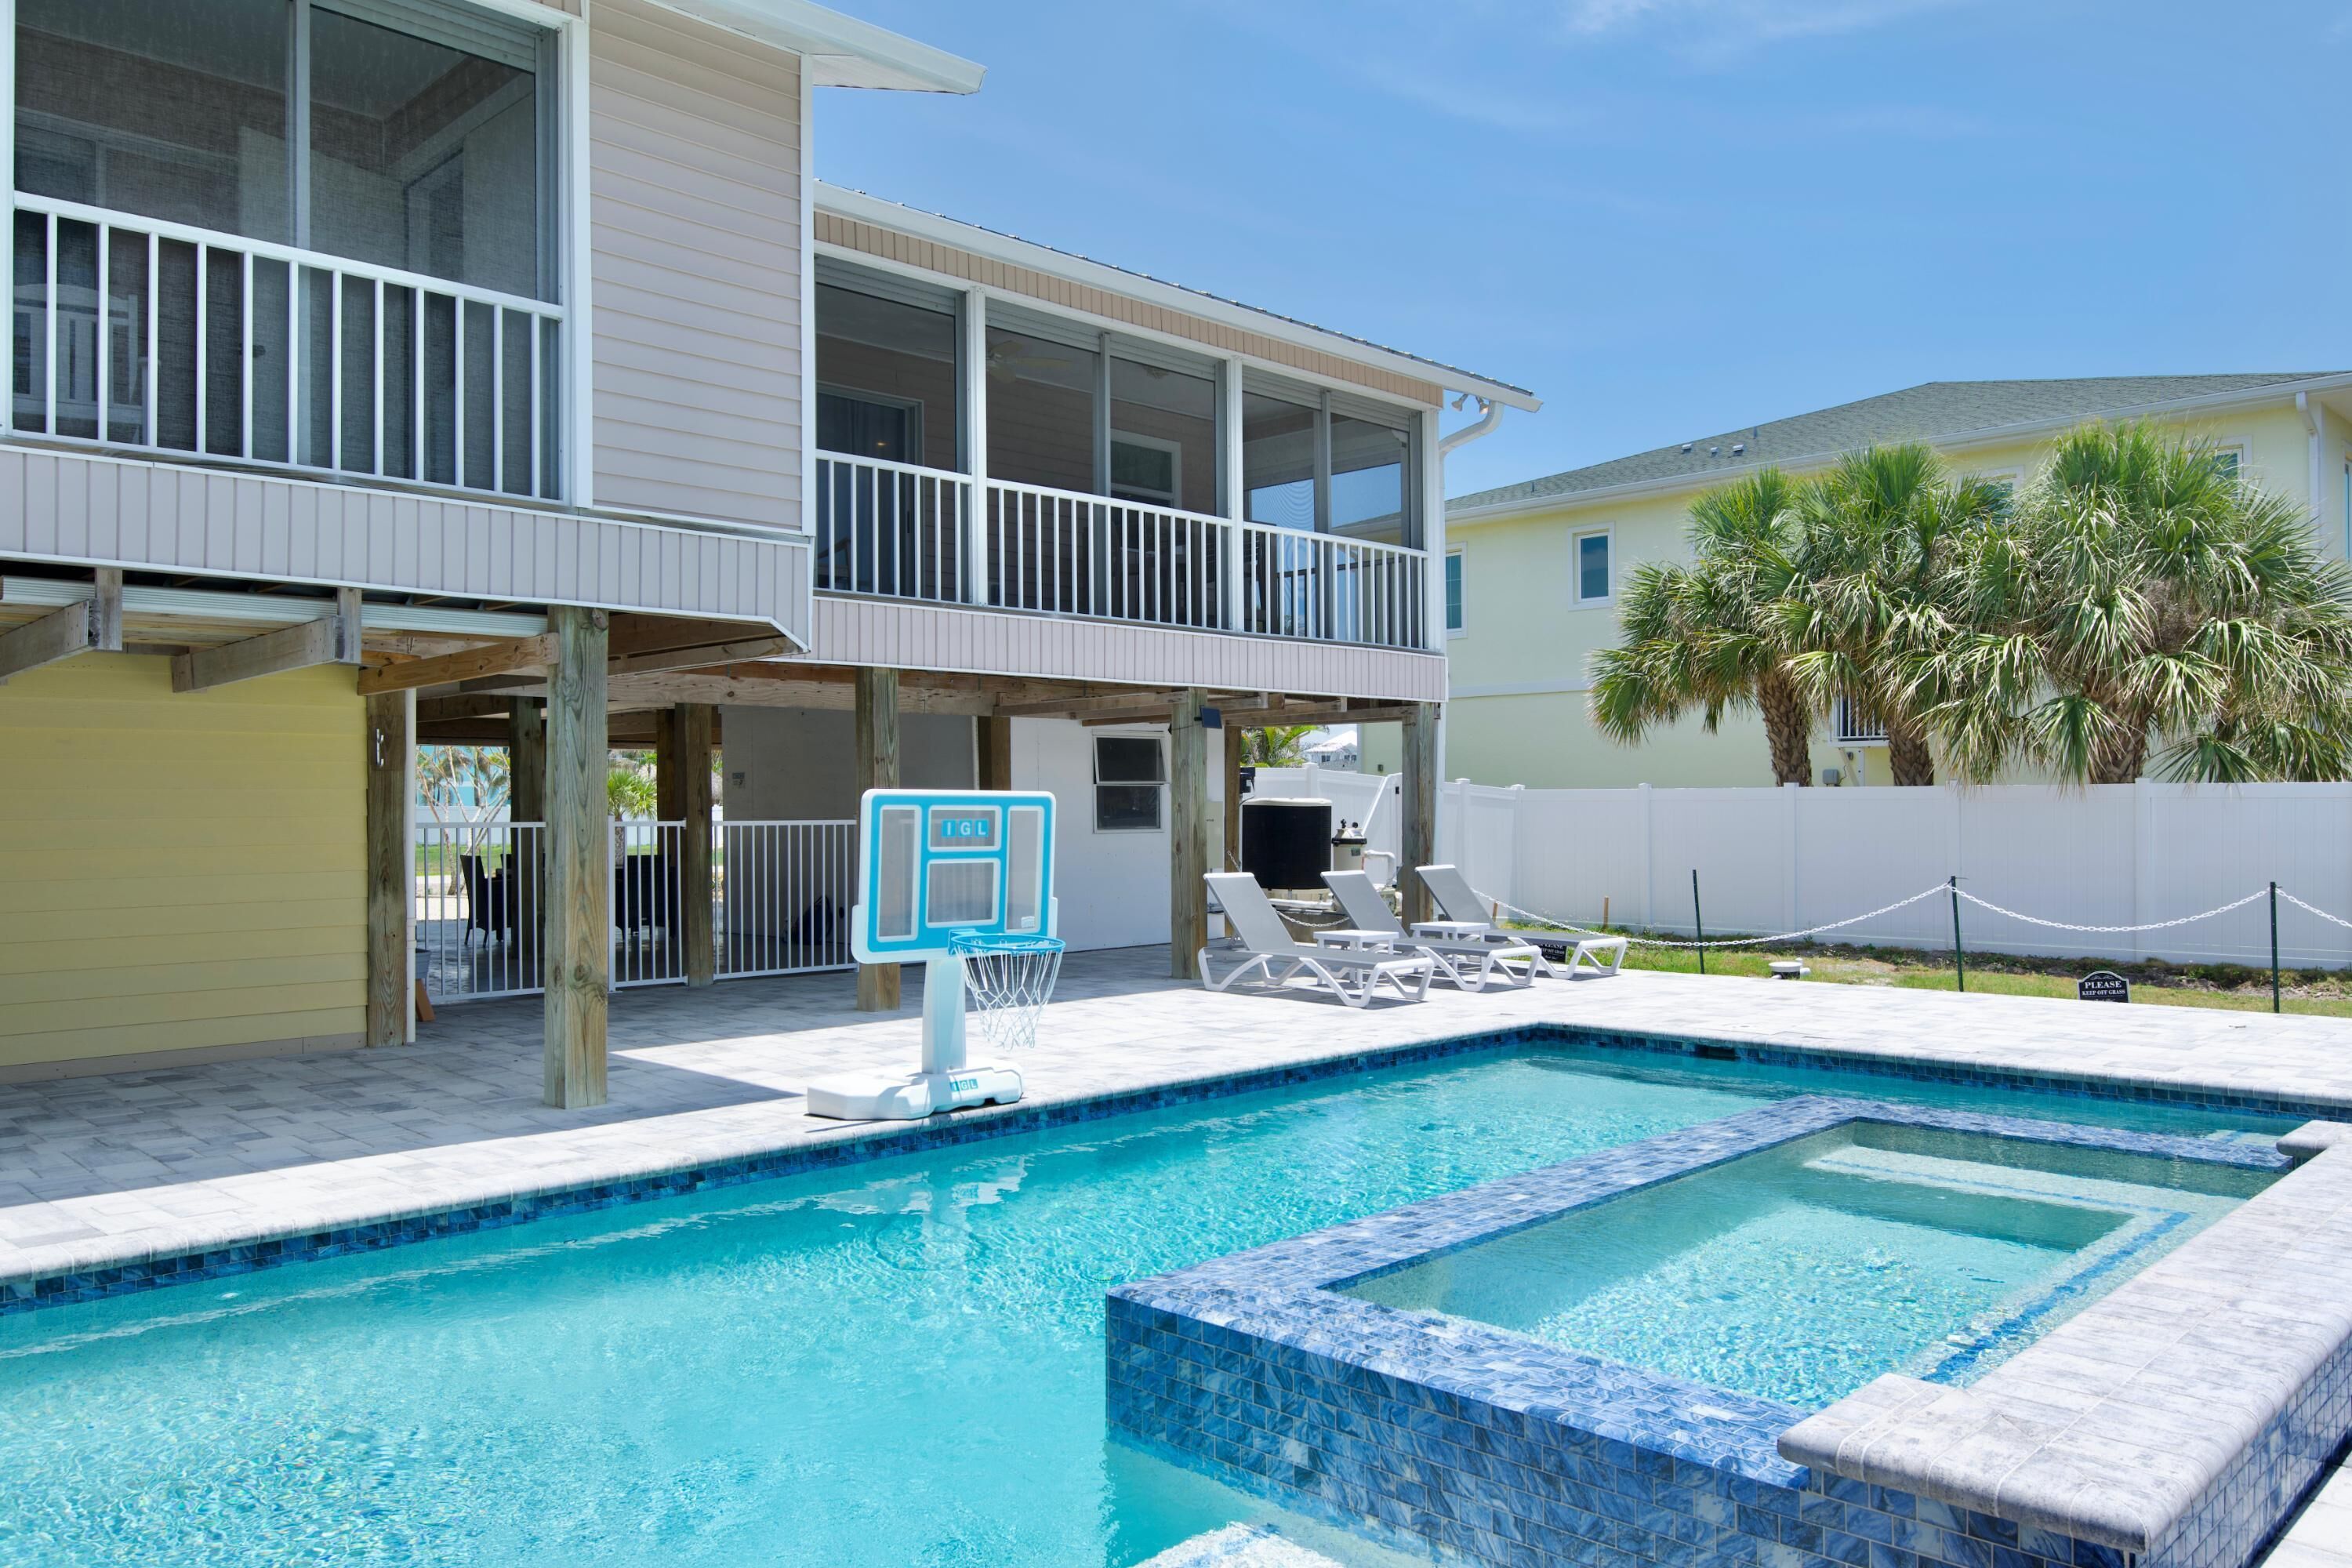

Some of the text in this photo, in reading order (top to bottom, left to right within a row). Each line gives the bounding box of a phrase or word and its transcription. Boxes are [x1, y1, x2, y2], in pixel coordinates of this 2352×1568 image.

[946, 821, 987, 836] IGL
[2085, 980, 2122, 989] PLEASE
[952, 1080, 977, 1091] IGL
